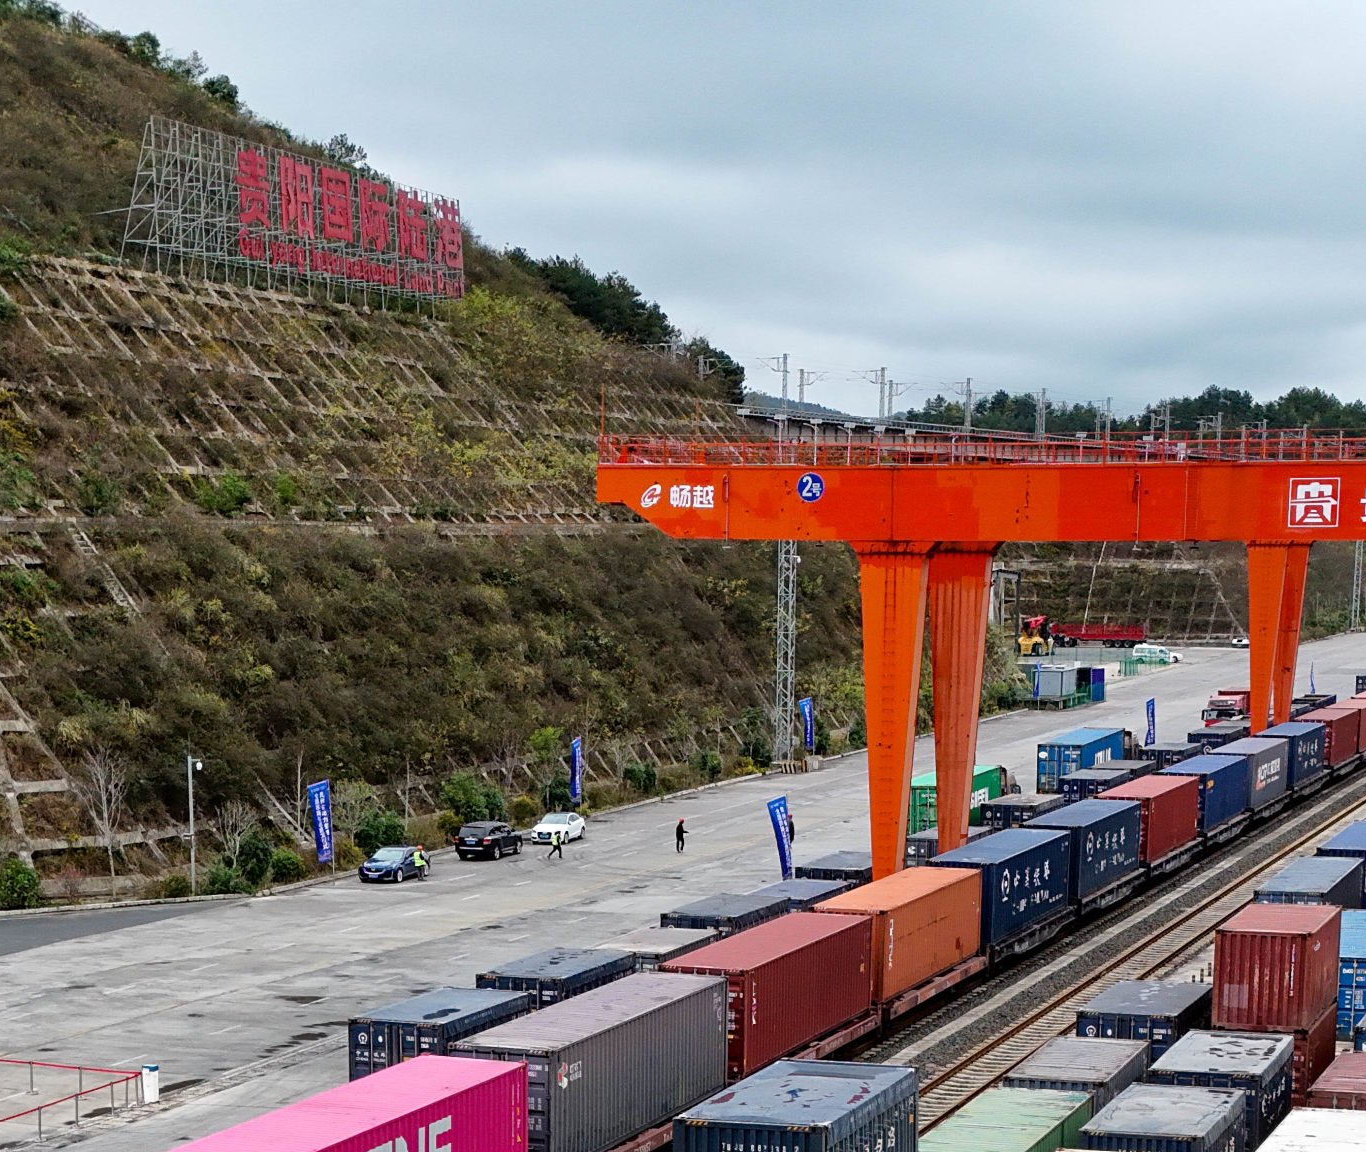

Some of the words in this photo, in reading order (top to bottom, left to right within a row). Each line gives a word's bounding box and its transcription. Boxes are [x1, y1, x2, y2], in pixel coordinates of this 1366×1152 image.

[235, 147, 463, 269] 贵阳国际陆港
[669, 485, 714, 508] 畅越
[802, 475, 822, 497] 2号
